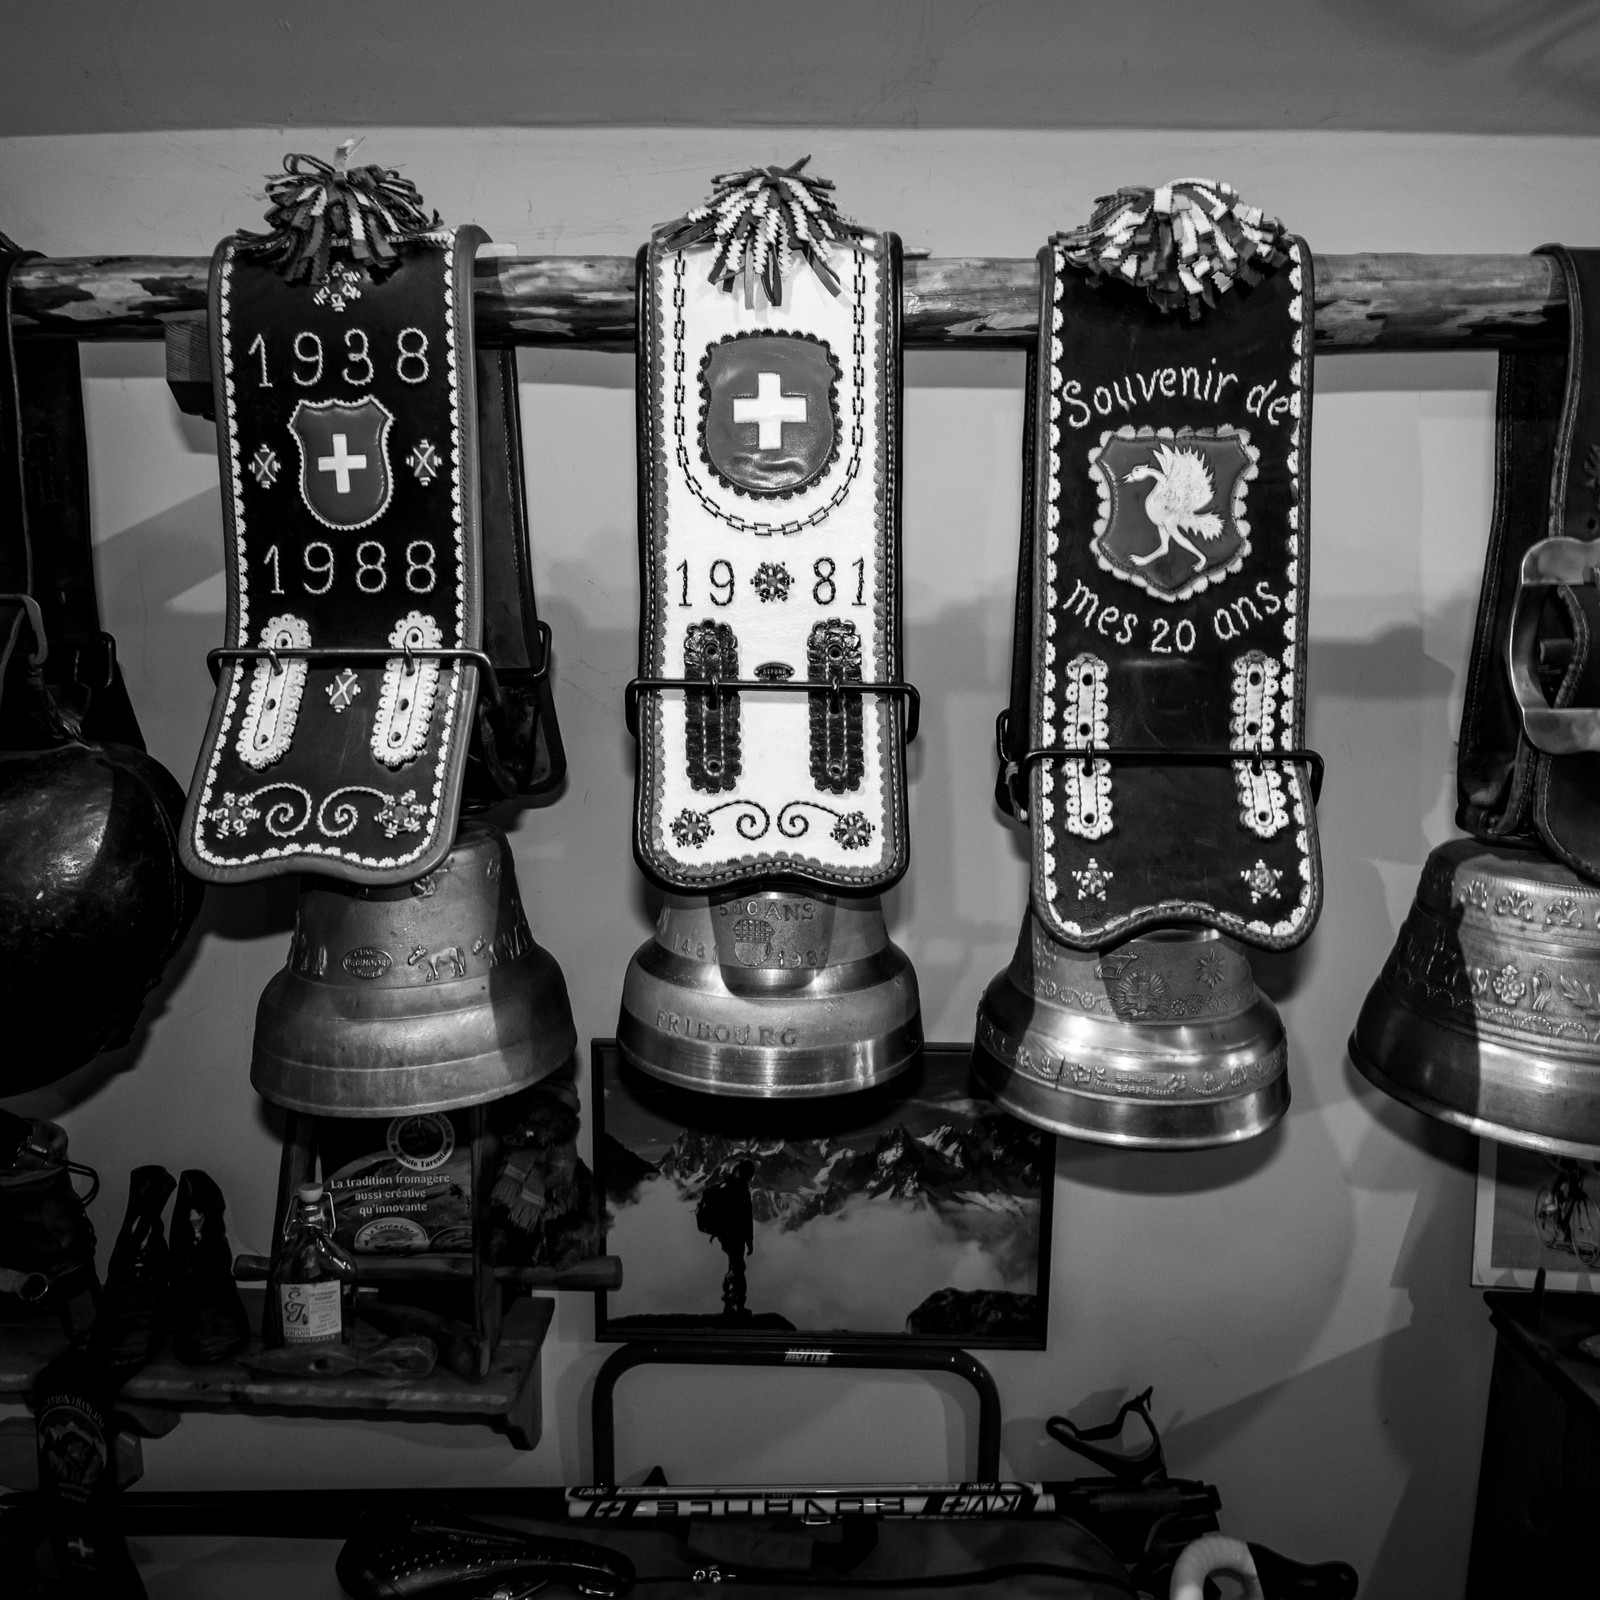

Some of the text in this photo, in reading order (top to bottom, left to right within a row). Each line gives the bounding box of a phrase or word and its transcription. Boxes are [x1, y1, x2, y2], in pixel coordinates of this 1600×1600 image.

[248, 327, 430, 389] 1938
[1061, 357, 1290, 429] Souvenir de
[263, 539, 437, 595] 1988
[1062, 578, 1282, 653] mes 20 ans
[718, 900, 817, 921] 500 ANS
[655, 1008, 797, 1047] FRIBOURG
[331, 1179, 344, 1189] La
[346, 1175, 393, 1188] tradition
[355, 1188, 426, 1201] aussi créative
[359, 1202, 428, 1217] qu'innovante
